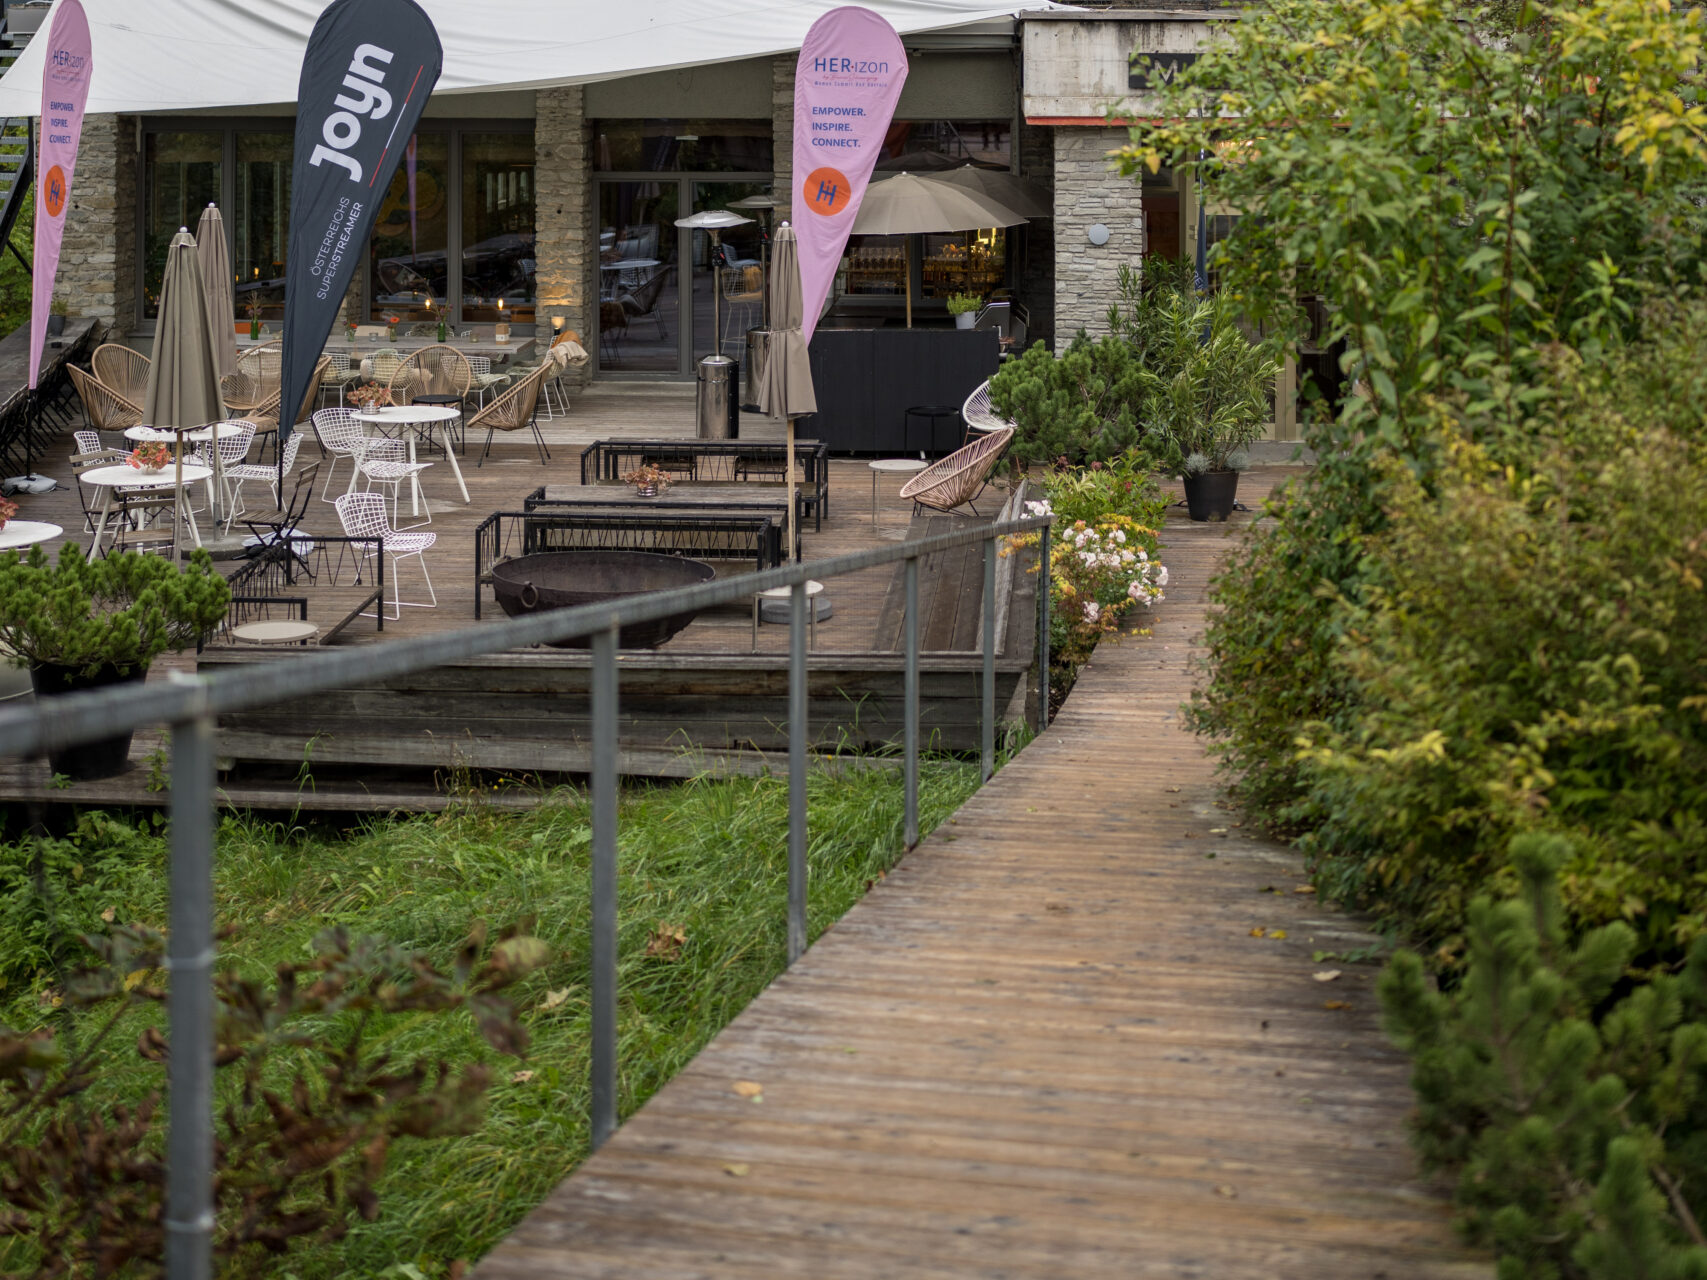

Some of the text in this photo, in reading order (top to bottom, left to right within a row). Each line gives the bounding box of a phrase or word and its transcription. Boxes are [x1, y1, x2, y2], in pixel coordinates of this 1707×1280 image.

[812, 106, 867, 117] EMPOWER.
[812, 122, 853, 132] INSPIRE.
[811, 137, 861, 148] CONNECT.
[310, 196, 350, 276] ÖSTERREICHS
[316, 202, 364, 300] SUPERSTREAMER
